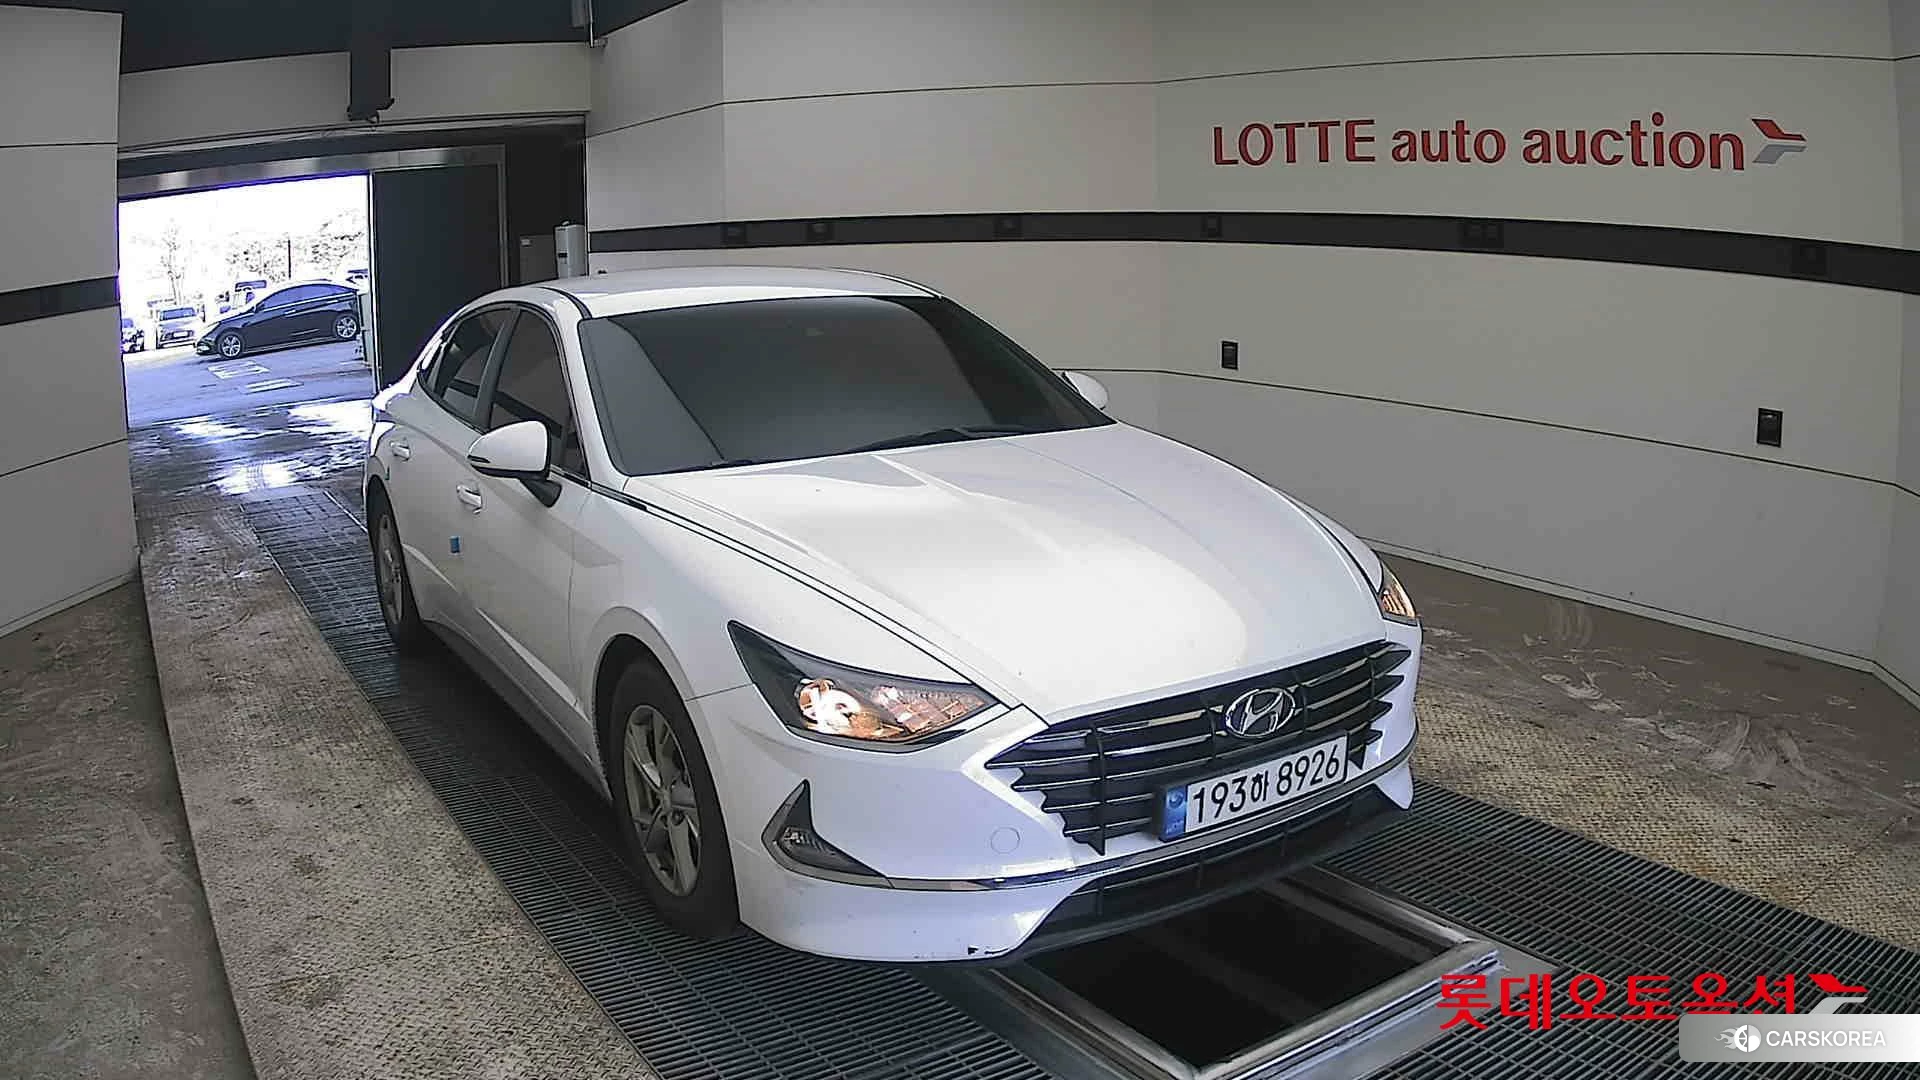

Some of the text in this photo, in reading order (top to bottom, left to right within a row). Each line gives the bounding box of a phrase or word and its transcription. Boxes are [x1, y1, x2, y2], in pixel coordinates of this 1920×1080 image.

[1213, 112, 1745, 171] LOTTE auto auction
[1192, 744, 1340, 823] 193하 8926
